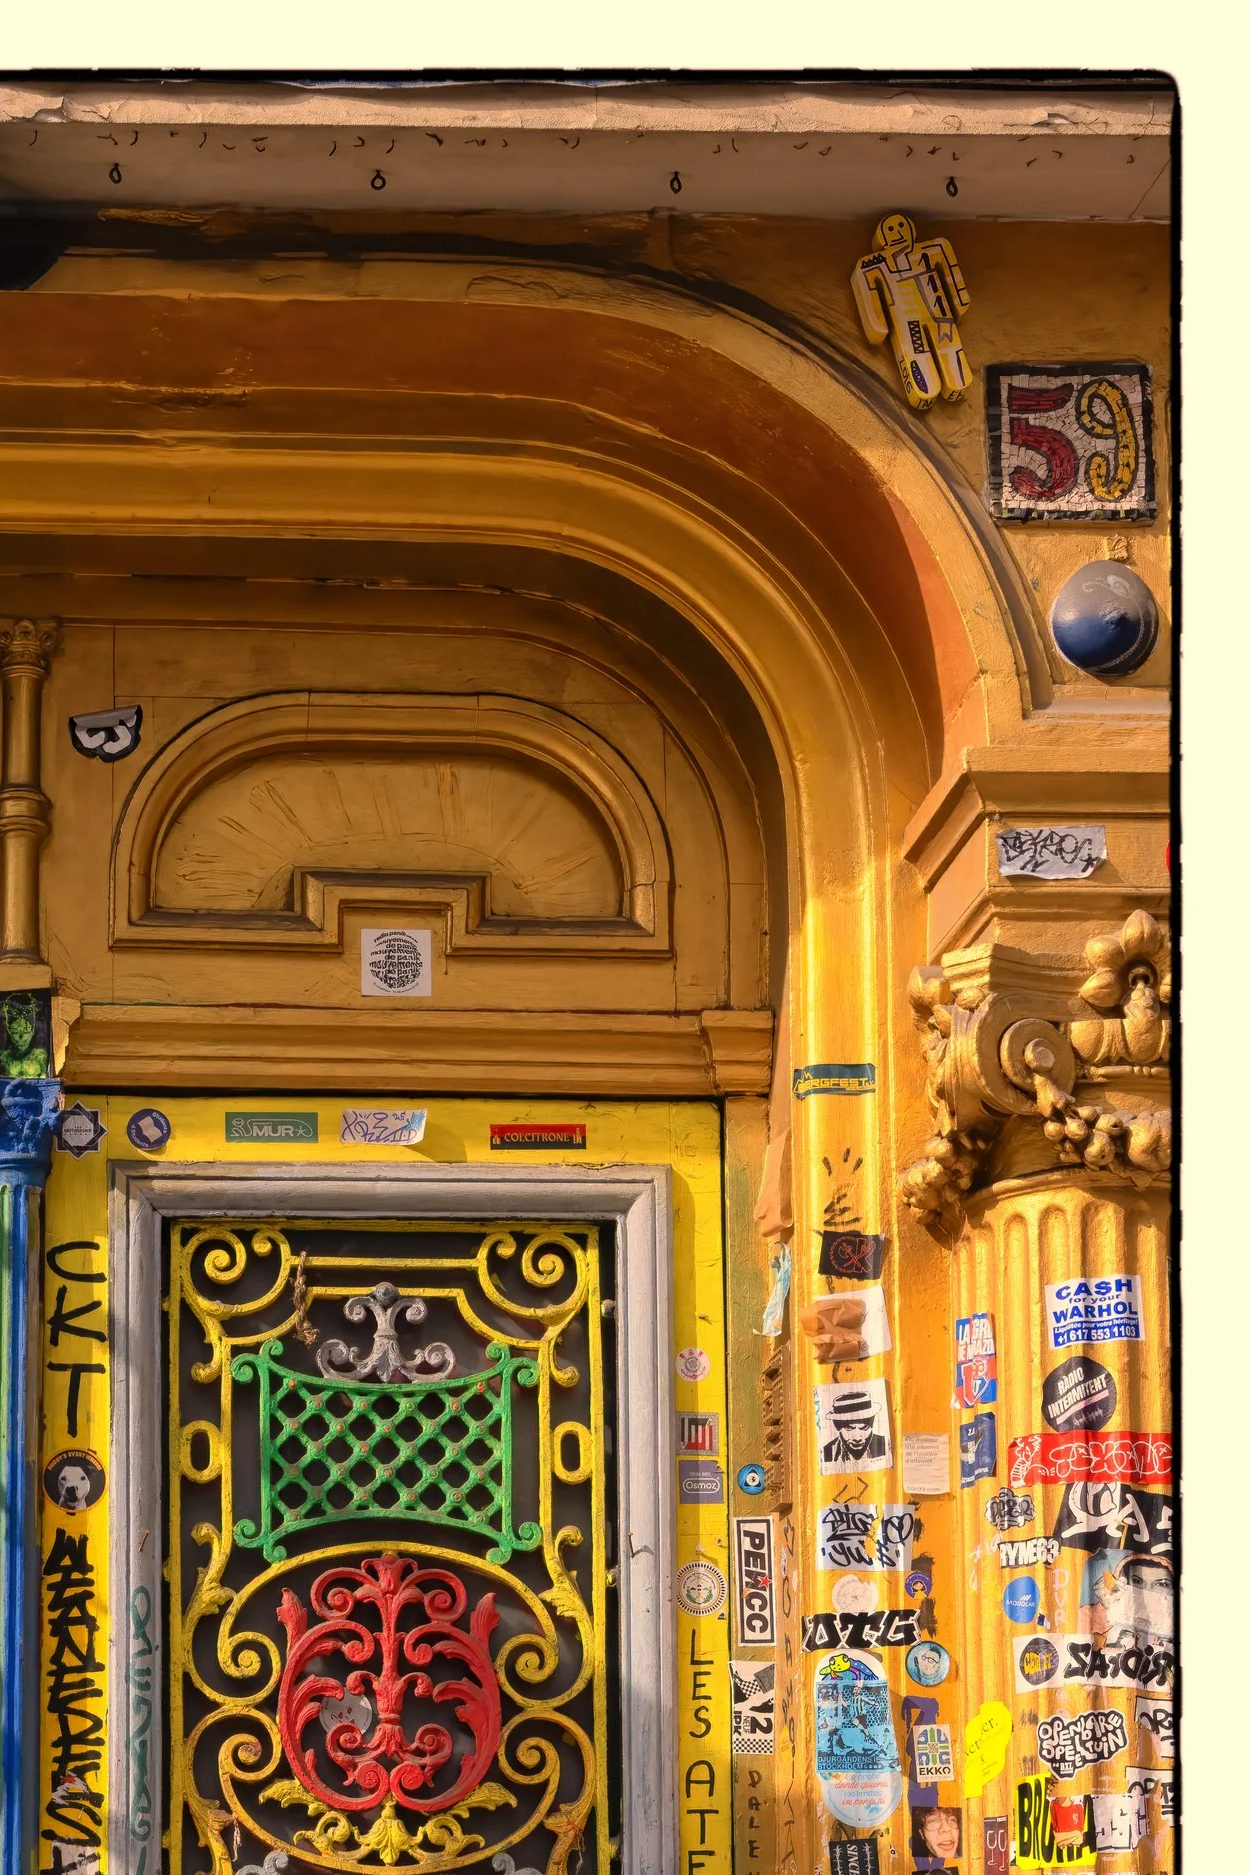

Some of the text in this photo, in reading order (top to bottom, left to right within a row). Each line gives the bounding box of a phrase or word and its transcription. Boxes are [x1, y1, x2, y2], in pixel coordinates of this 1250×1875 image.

[1006, 379, 1138, 501] 59
[505, 1132, 571, 1144] COLCITRONE
[1091, 1294, 1121, 1304] your
[1053, 1301, 1138, 1324] WARHOL
[1070, 1329, 1088, 1341] 617
[1091, 1328, 1110, 1340] 553
[1113, 1326, 1136, 1337] 1103
[685, 1479, 718, 1492] Osmoz
[689, 1629, 713, 1739] LES
[919, 1767, 951, 1776] EKKO
[846, 1844, 859, 1875] SINCE
